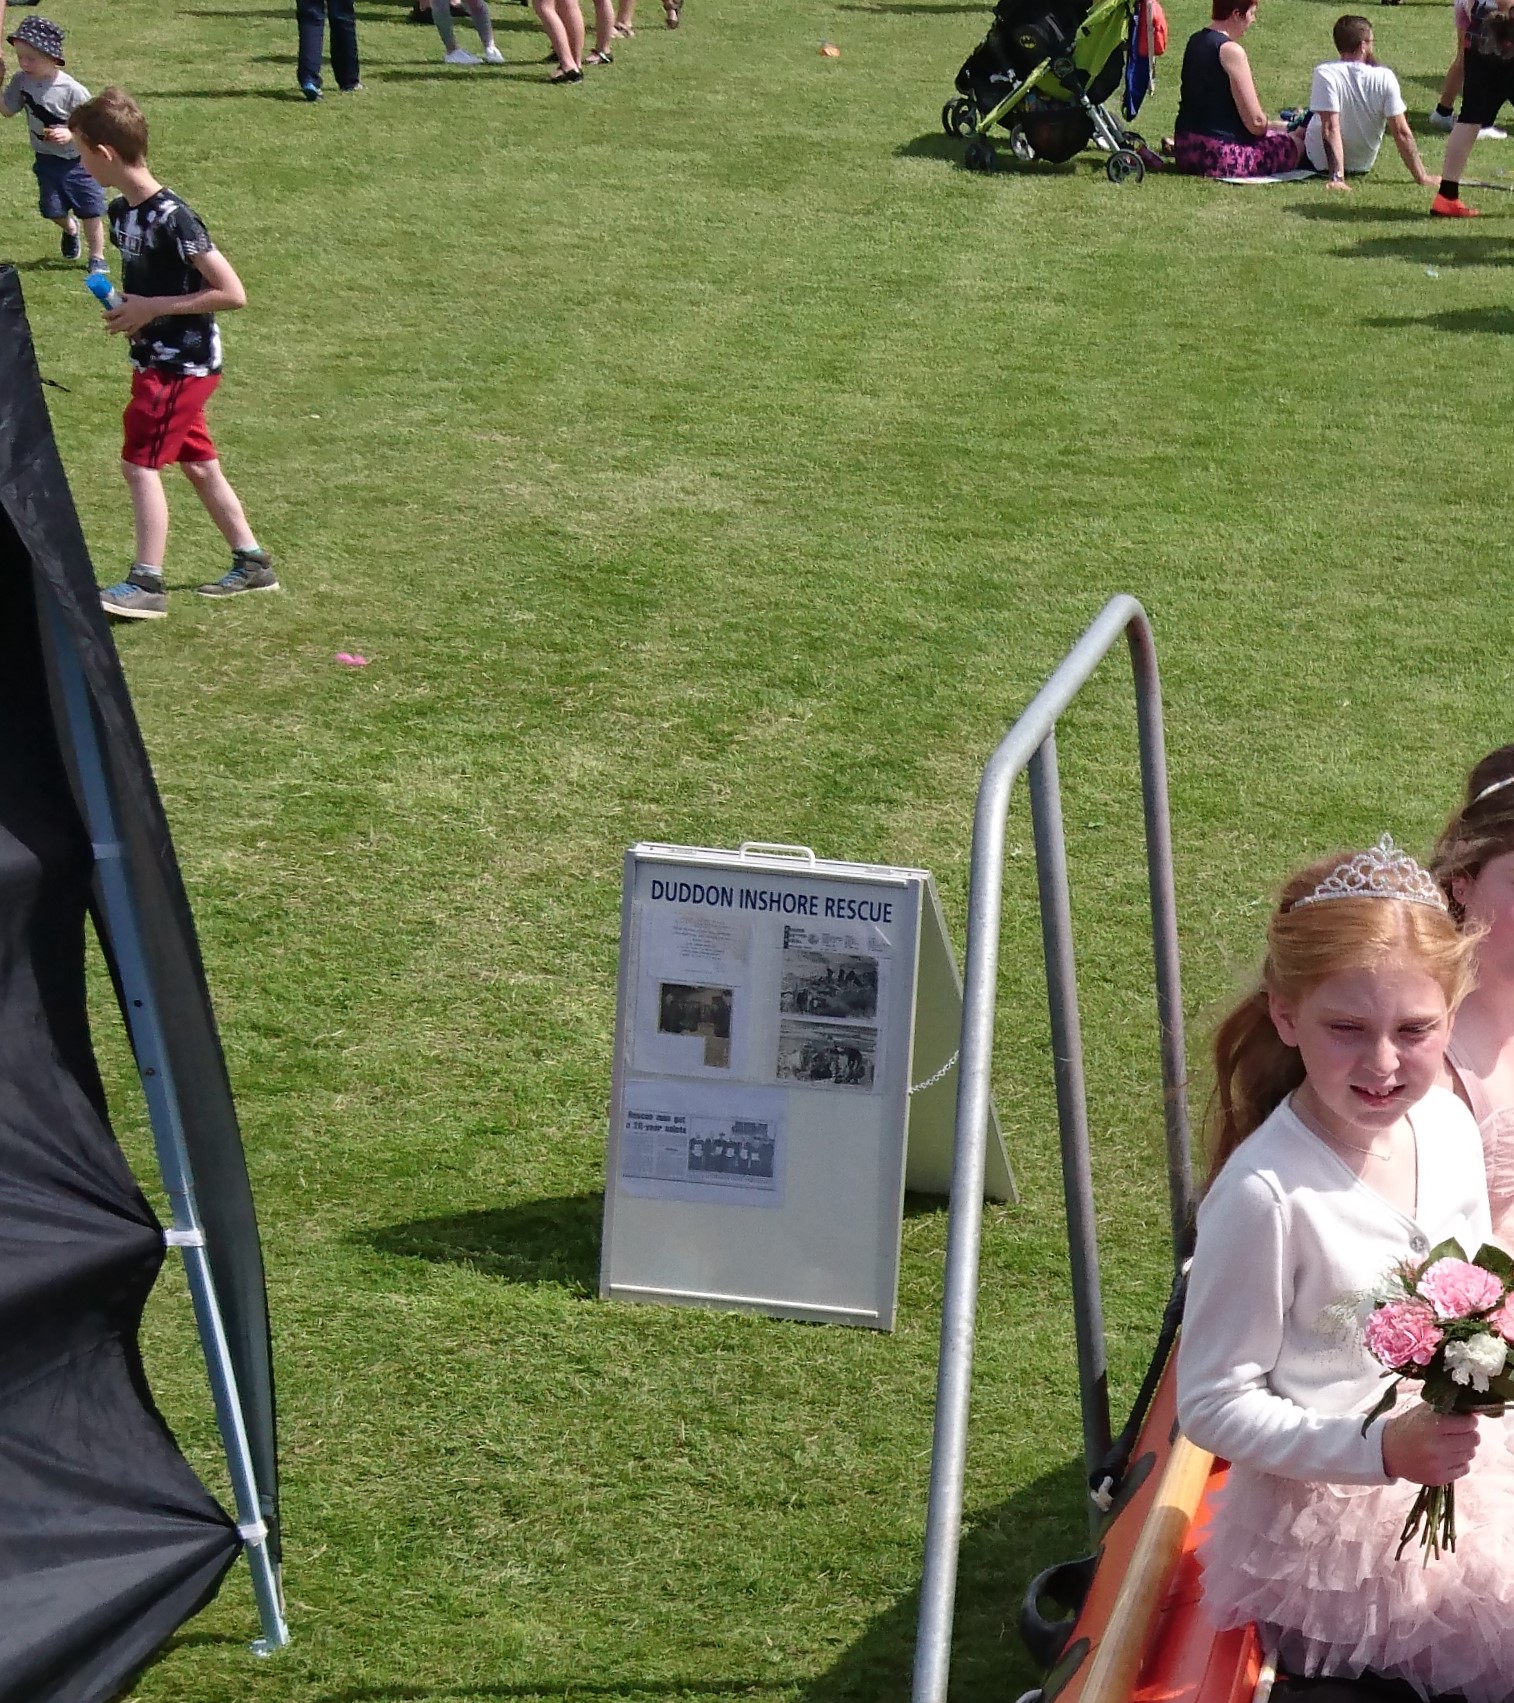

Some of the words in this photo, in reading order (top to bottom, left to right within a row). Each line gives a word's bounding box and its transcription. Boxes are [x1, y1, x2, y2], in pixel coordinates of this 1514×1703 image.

[651, 879, 734, 908] DUDDON
[739, 888, 819, 916] INSHORE
[824, 896, 893, 923] RESCUE
